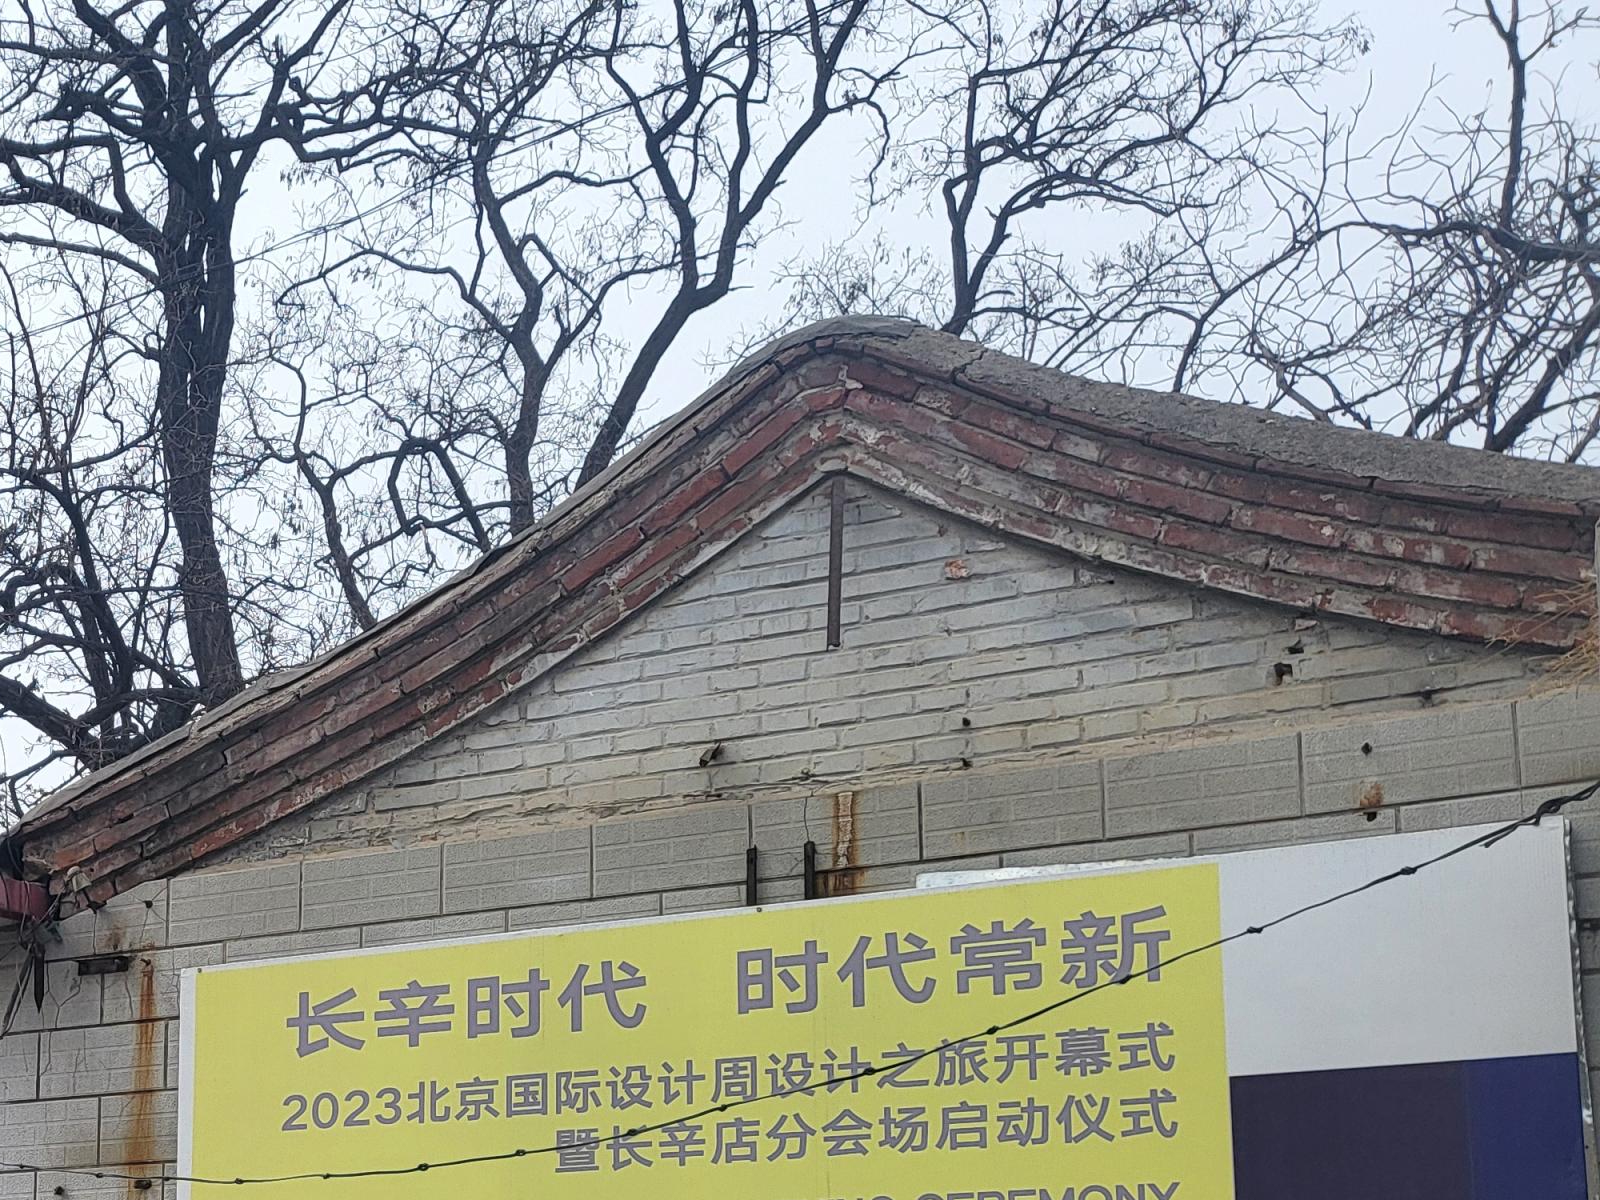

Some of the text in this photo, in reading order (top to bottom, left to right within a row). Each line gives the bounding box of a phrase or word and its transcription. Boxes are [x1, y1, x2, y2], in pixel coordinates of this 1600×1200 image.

[286, 904, 1173, 1059] 长辛时代 时代常新
[281, 1021, 1176, 1134] 2023北京国际设计周设计之旅开幕式
[553, 1086, 1178, 1175] 暨长辛店分会场启动仪式
